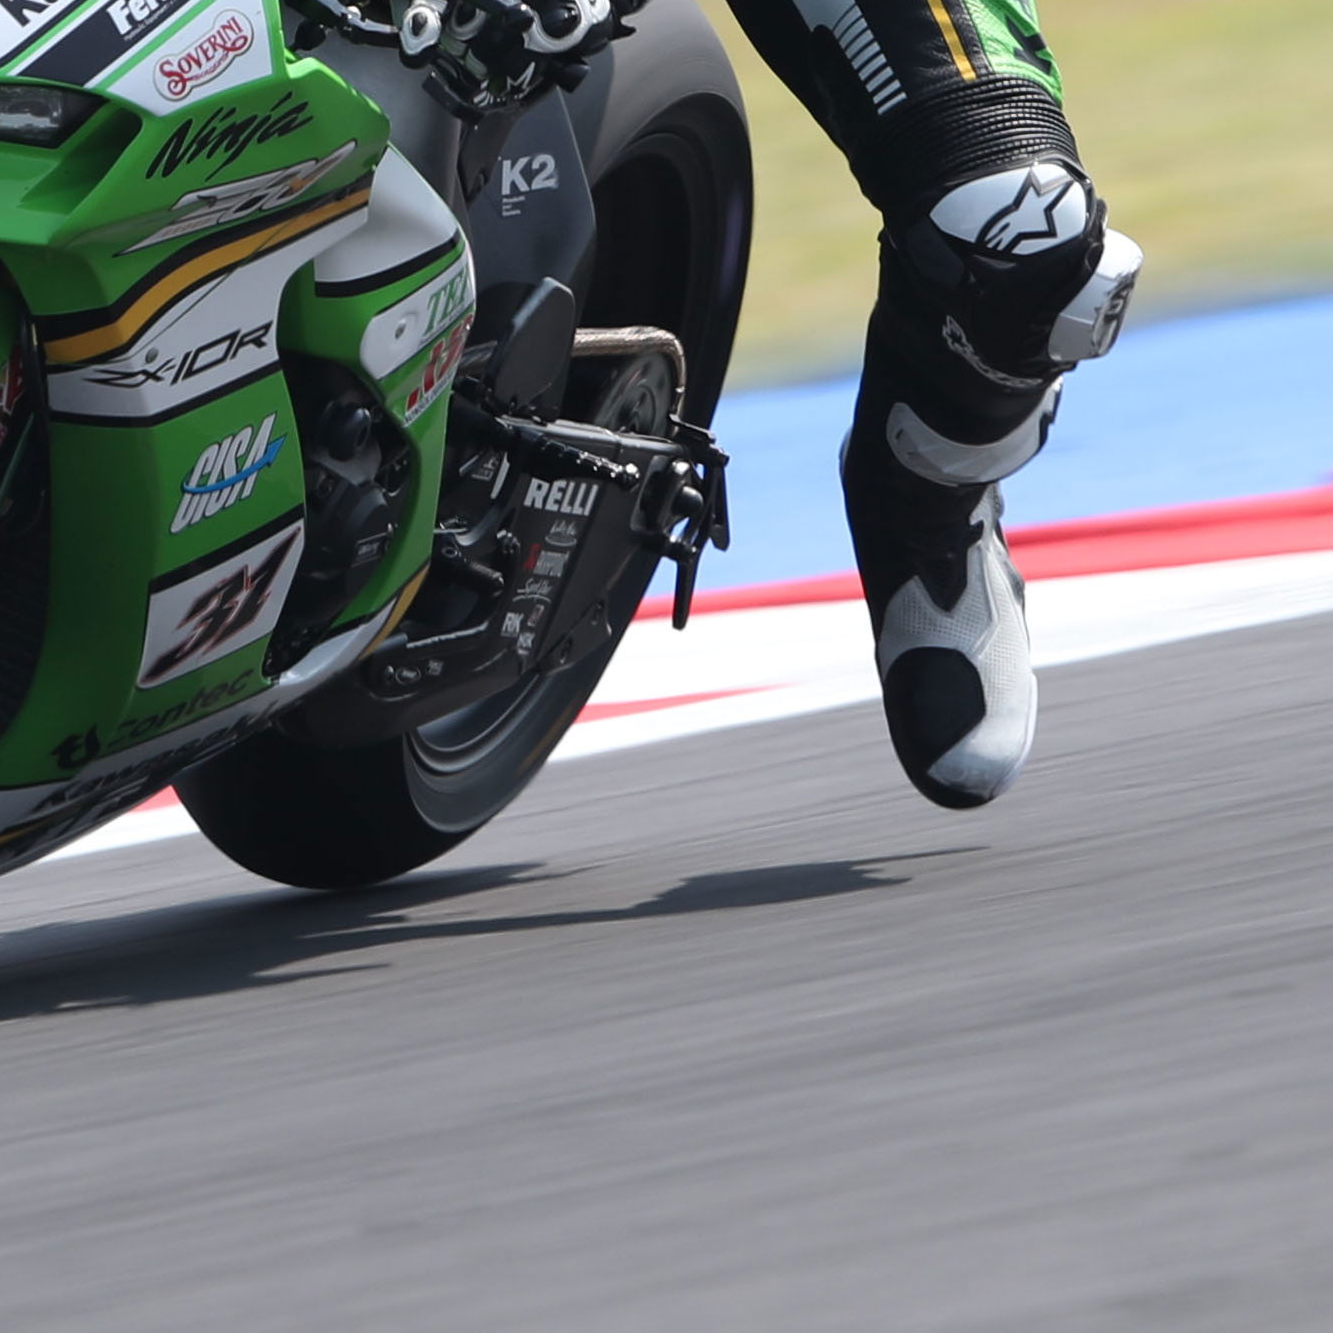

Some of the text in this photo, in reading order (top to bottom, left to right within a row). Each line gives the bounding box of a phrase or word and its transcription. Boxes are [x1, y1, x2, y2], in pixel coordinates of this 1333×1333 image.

[159, 16, 248, 96] SOVERINI
[145, 90, 314, 182] Ninja
[502, 154, 559, 195] K2
[81, 320, 274, 389] ZX-10R
[137, 526, 302, 684] 31
